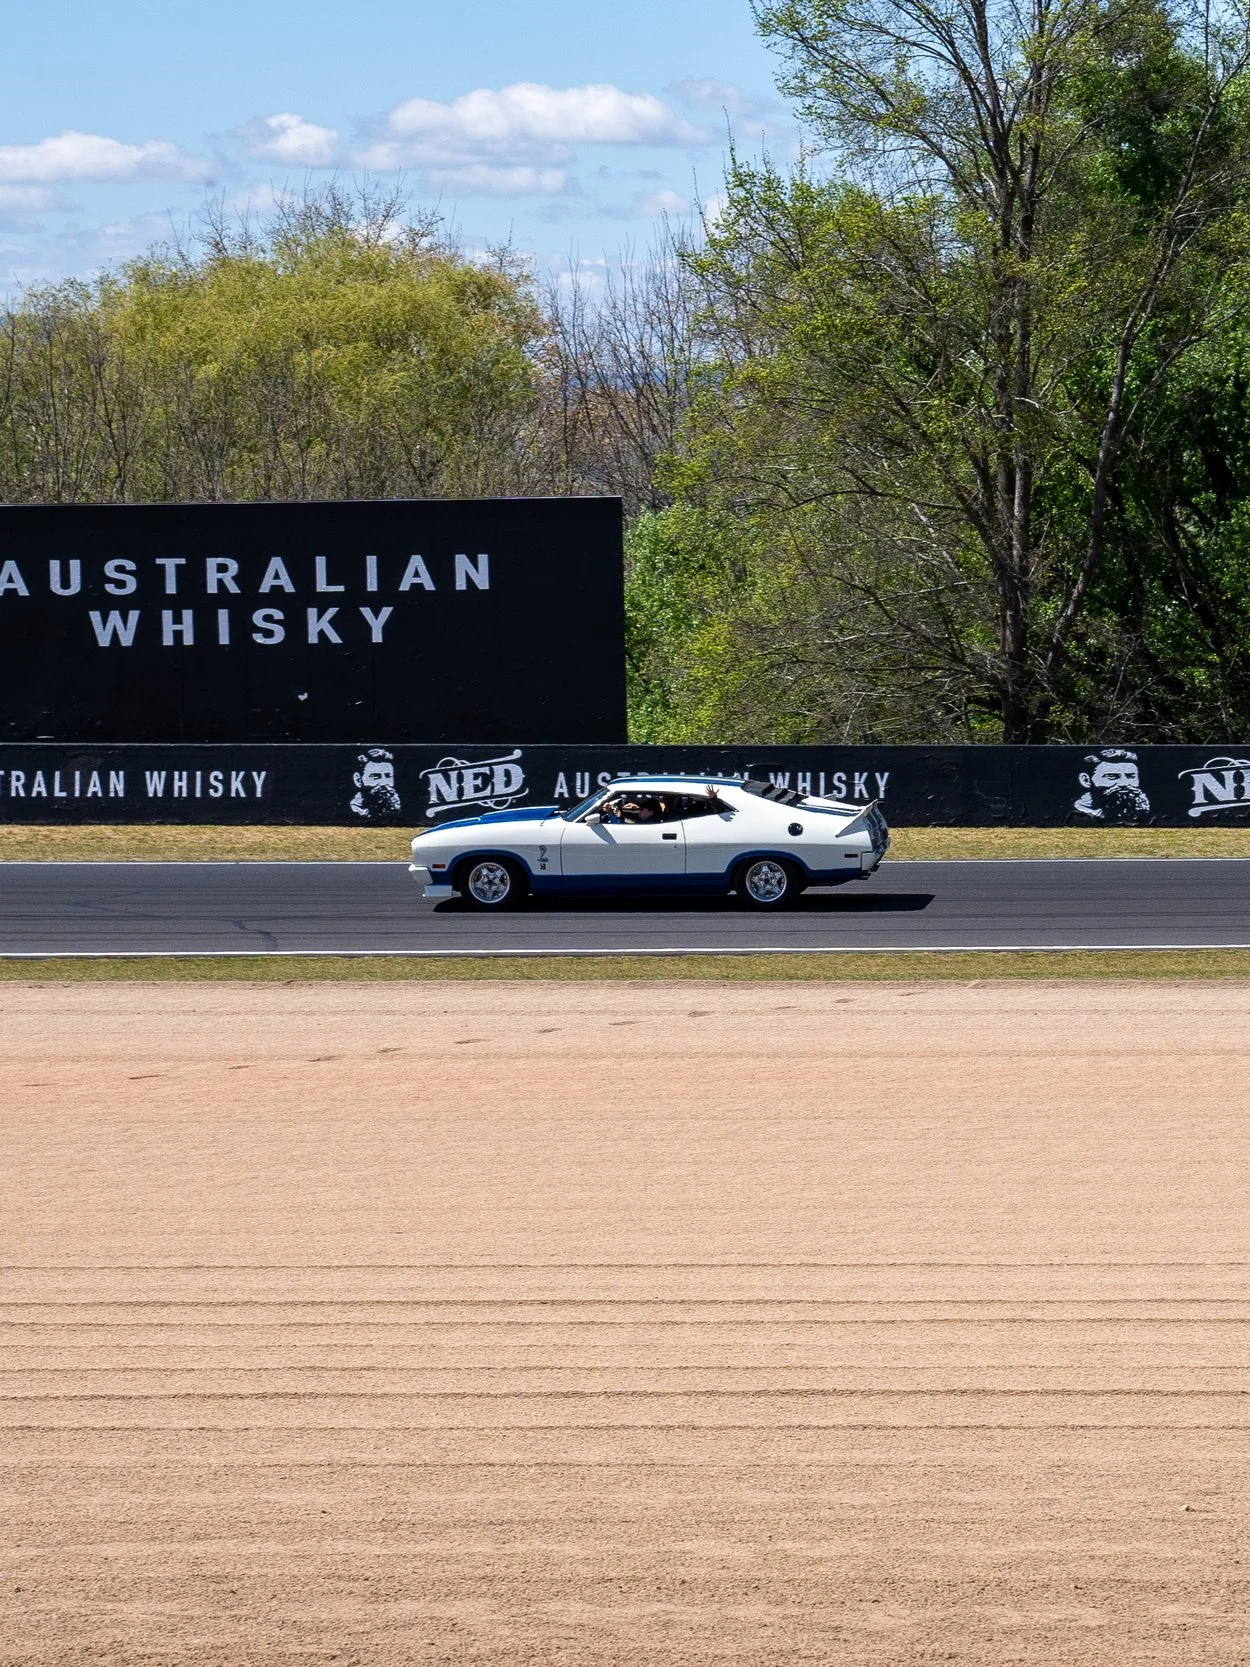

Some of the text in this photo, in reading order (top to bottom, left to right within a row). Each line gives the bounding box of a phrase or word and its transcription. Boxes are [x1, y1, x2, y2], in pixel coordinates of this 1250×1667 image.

[0, 554, 490, 597] AUSTRALIAN
[89, 606, 395, 647] WHISKY
[145, 770, 267, 798] WHISKY
[427, 762, 526, 804] NED
[769, 772, 890, 799] WHISKY
